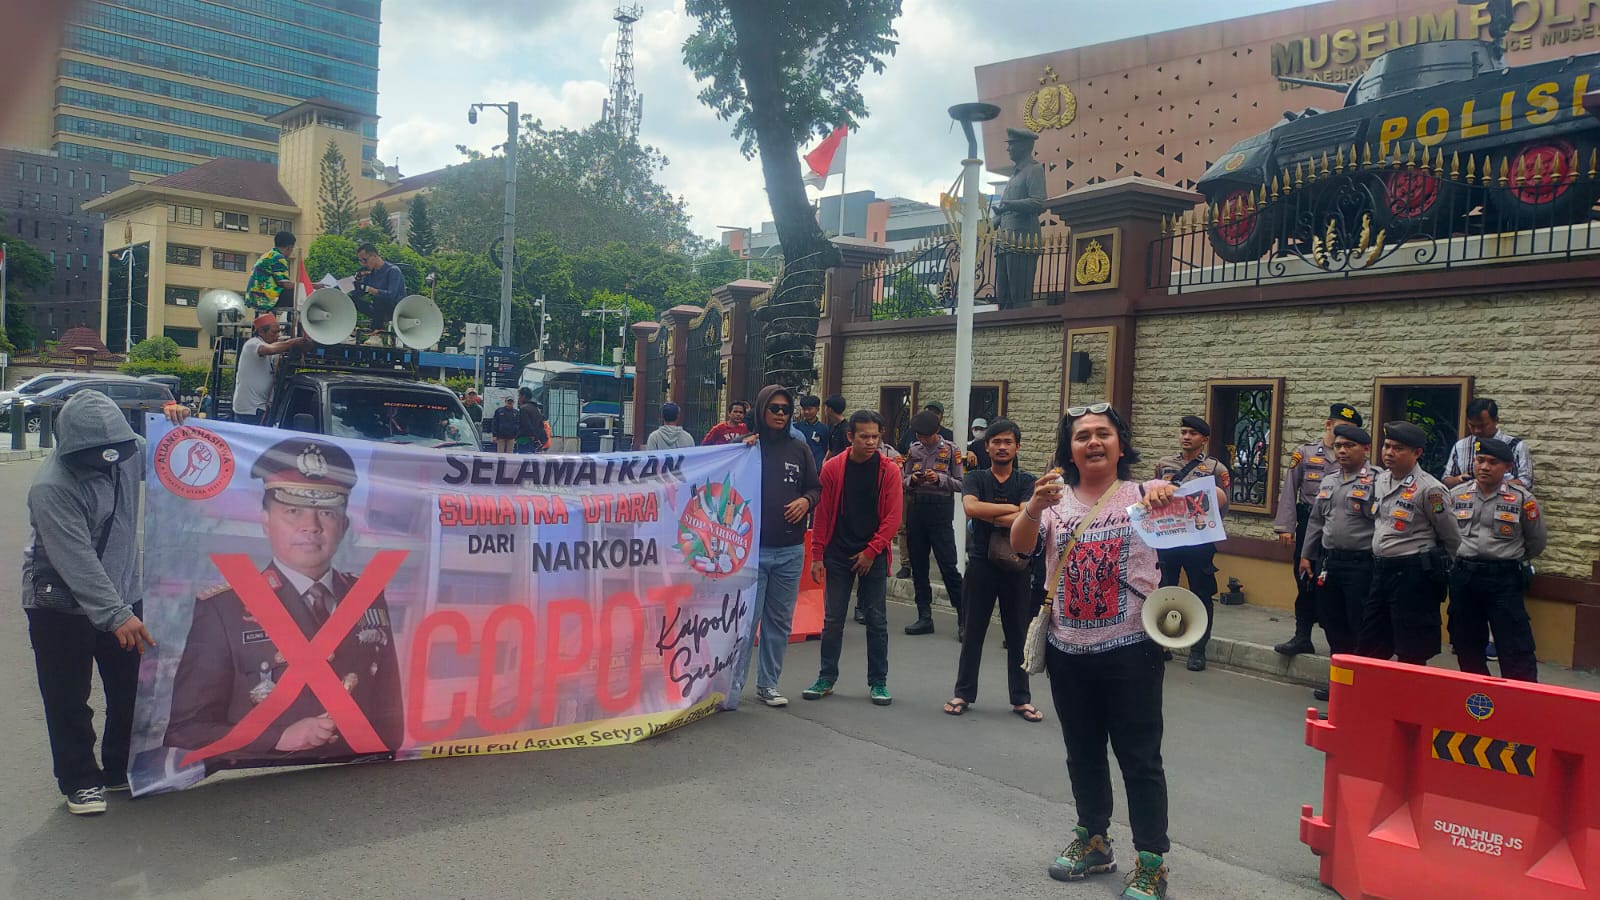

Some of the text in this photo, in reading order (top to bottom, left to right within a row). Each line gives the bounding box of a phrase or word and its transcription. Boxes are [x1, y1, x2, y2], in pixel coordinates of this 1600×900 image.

[1270, 7, 1456, 77] MUSEUM
[1379, 74, 1590, 155] POLISI
[443, 454, 687, 485] SELAMATKAN
[439, 491, 659, 526] SUMATRA UTARA
[468, 534, 515, 554] DARI
[685, 513, 748, 548] STOP NARKOBA
[532, 538, 658, 573] NARKOBA
[656, 589, 747, 656] Kapolda
[407, 583, 693, 742] COPOT
[524, 733, 587, 749] Agung
[590, 726, 644, 743] Setya
[1434, 820, 1523, 850] SUDINHUB JS
[1451, 836, 1502, 856] TA.2023
